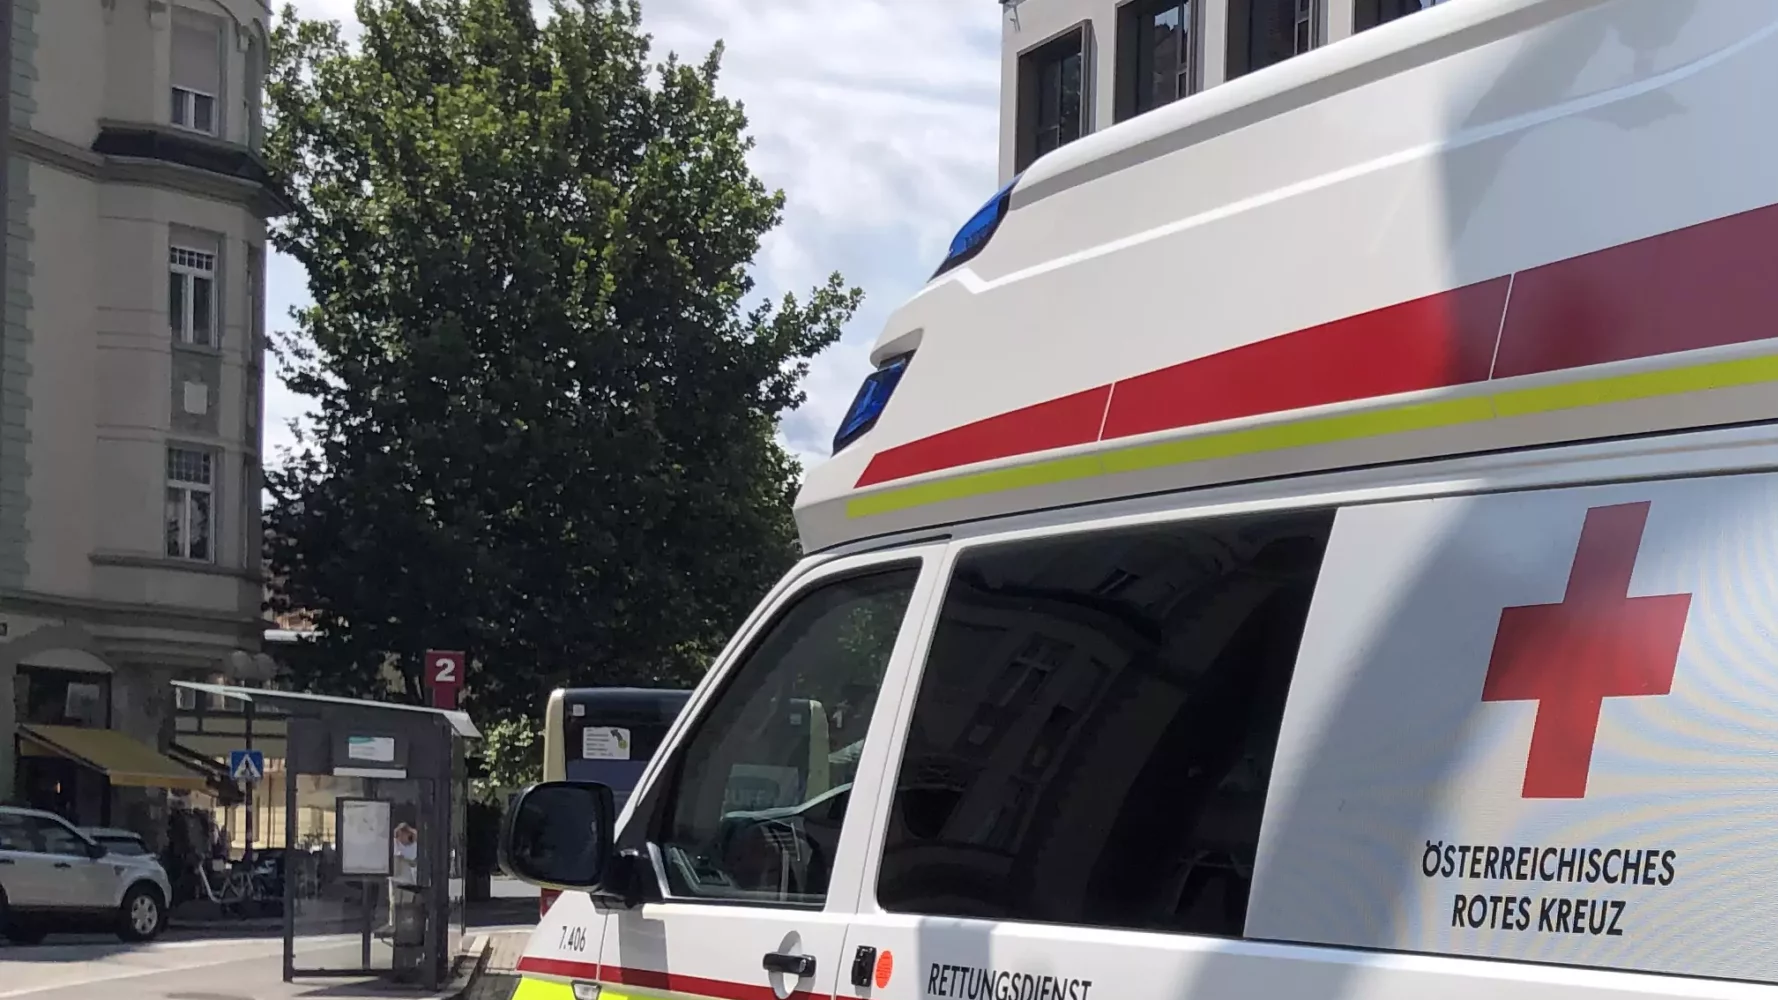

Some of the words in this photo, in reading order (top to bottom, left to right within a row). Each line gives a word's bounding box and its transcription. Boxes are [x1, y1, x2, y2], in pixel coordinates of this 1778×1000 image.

[435, 657, 456, 682] 2
[1422, 840, 1677, 886] ÖSTERREICHISCHES
[1451, 894, 1532, 931] ROTES
[1538, 897, 1626, 936] KREUZ
[559, 925, 587, 952] 7.406
